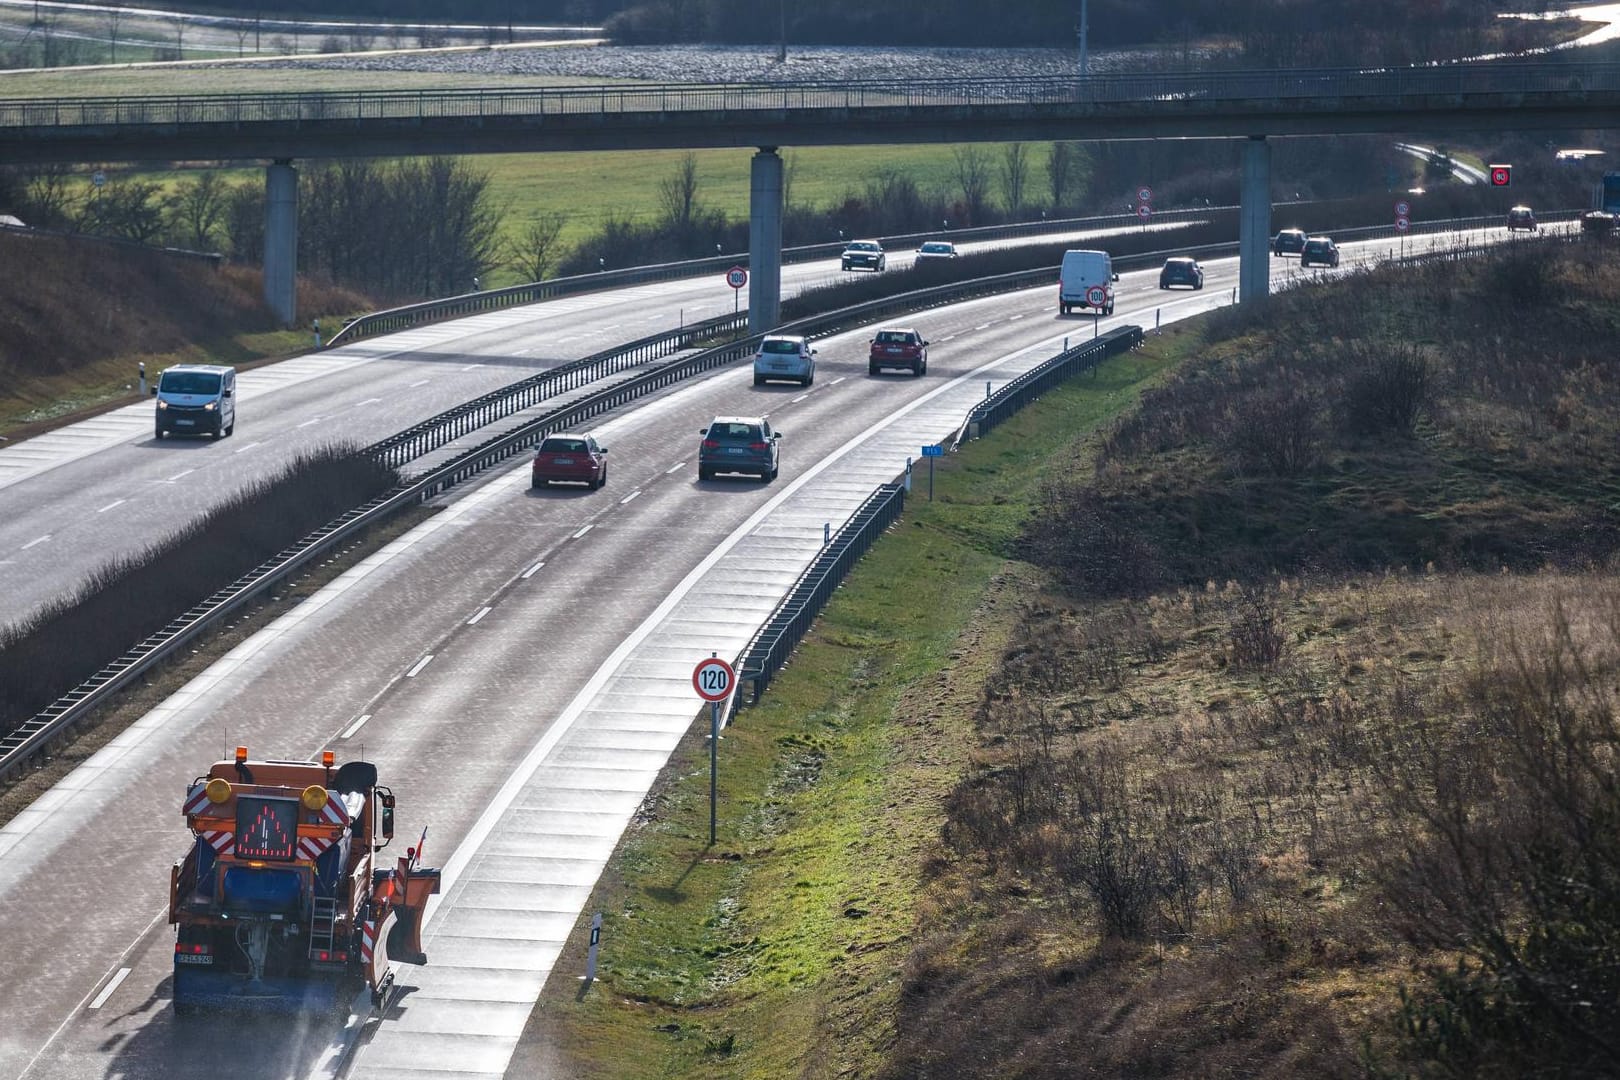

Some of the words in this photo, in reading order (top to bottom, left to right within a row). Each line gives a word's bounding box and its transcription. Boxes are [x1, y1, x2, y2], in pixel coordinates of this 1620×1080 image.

[731, 272, 744, 283] 100
[1091, 291, 1103, 302] 100
[701, 670, 727, 690] 120
